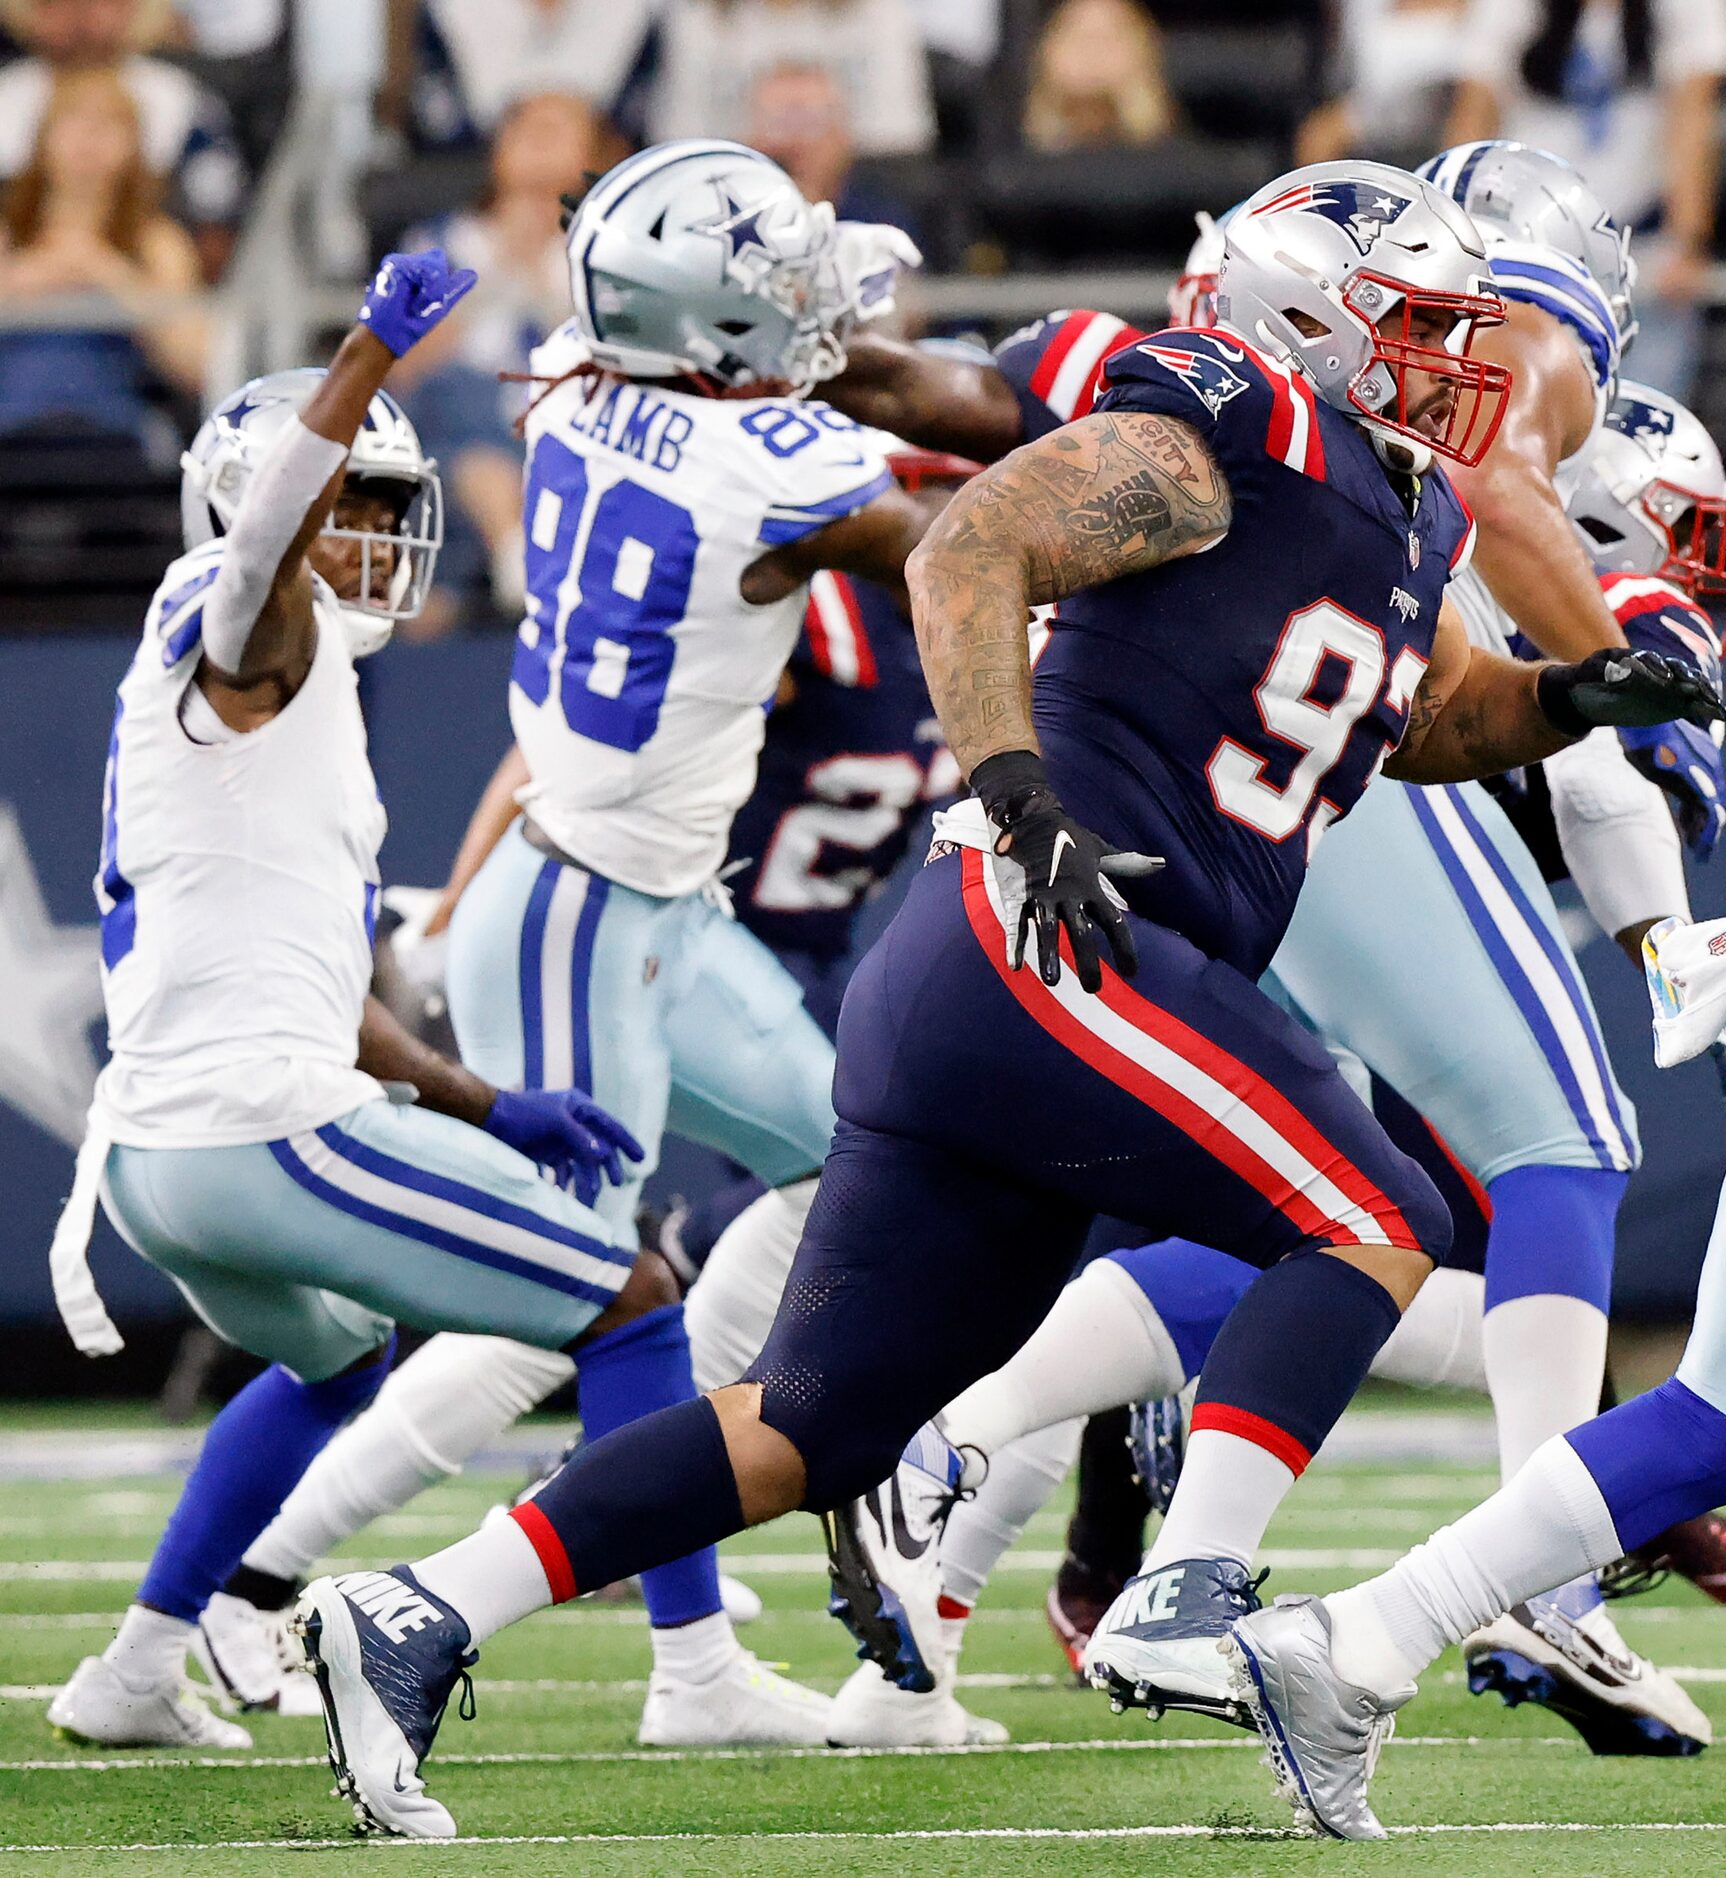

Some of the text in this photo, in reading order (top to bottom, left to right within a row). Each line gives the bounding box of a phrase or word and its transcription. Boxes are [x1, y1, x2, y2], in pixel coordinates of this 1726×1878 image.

[1141, 420, 1199, 483] CITY
[752, 748, 962, 913] 2
[333, 1570, 446, 1646] NIKE
[1107, 1567, 1187, 1634] IKE
